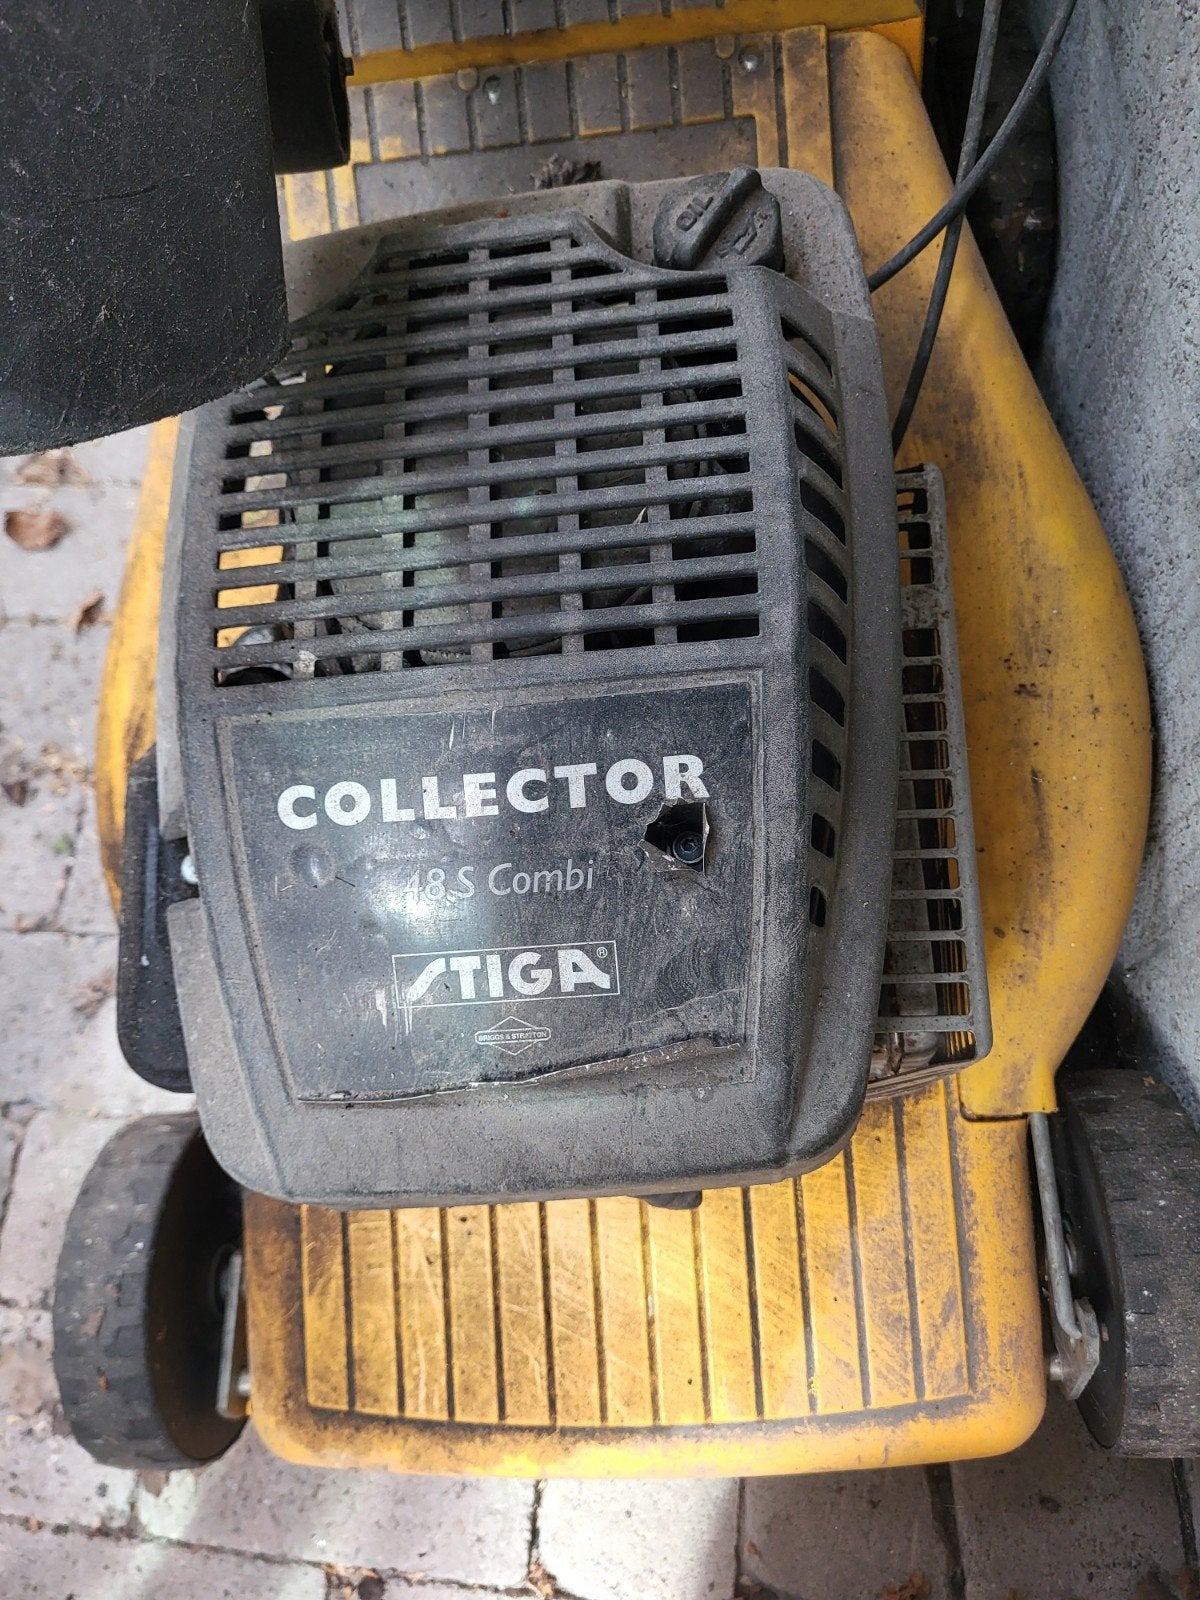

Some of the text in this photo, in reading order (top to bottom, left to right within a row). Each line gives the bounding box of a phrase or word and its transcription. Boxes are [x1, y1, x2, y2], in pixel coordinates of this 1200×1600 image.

[675, 196, 714, 232] OIL
[277, 754, 709, 830] COLLECTOR
[488, 859, 594, 896] Combi
[405, 949, 611, 1001] STIGA
[511, 1031, 547, 1039] STRATTON
